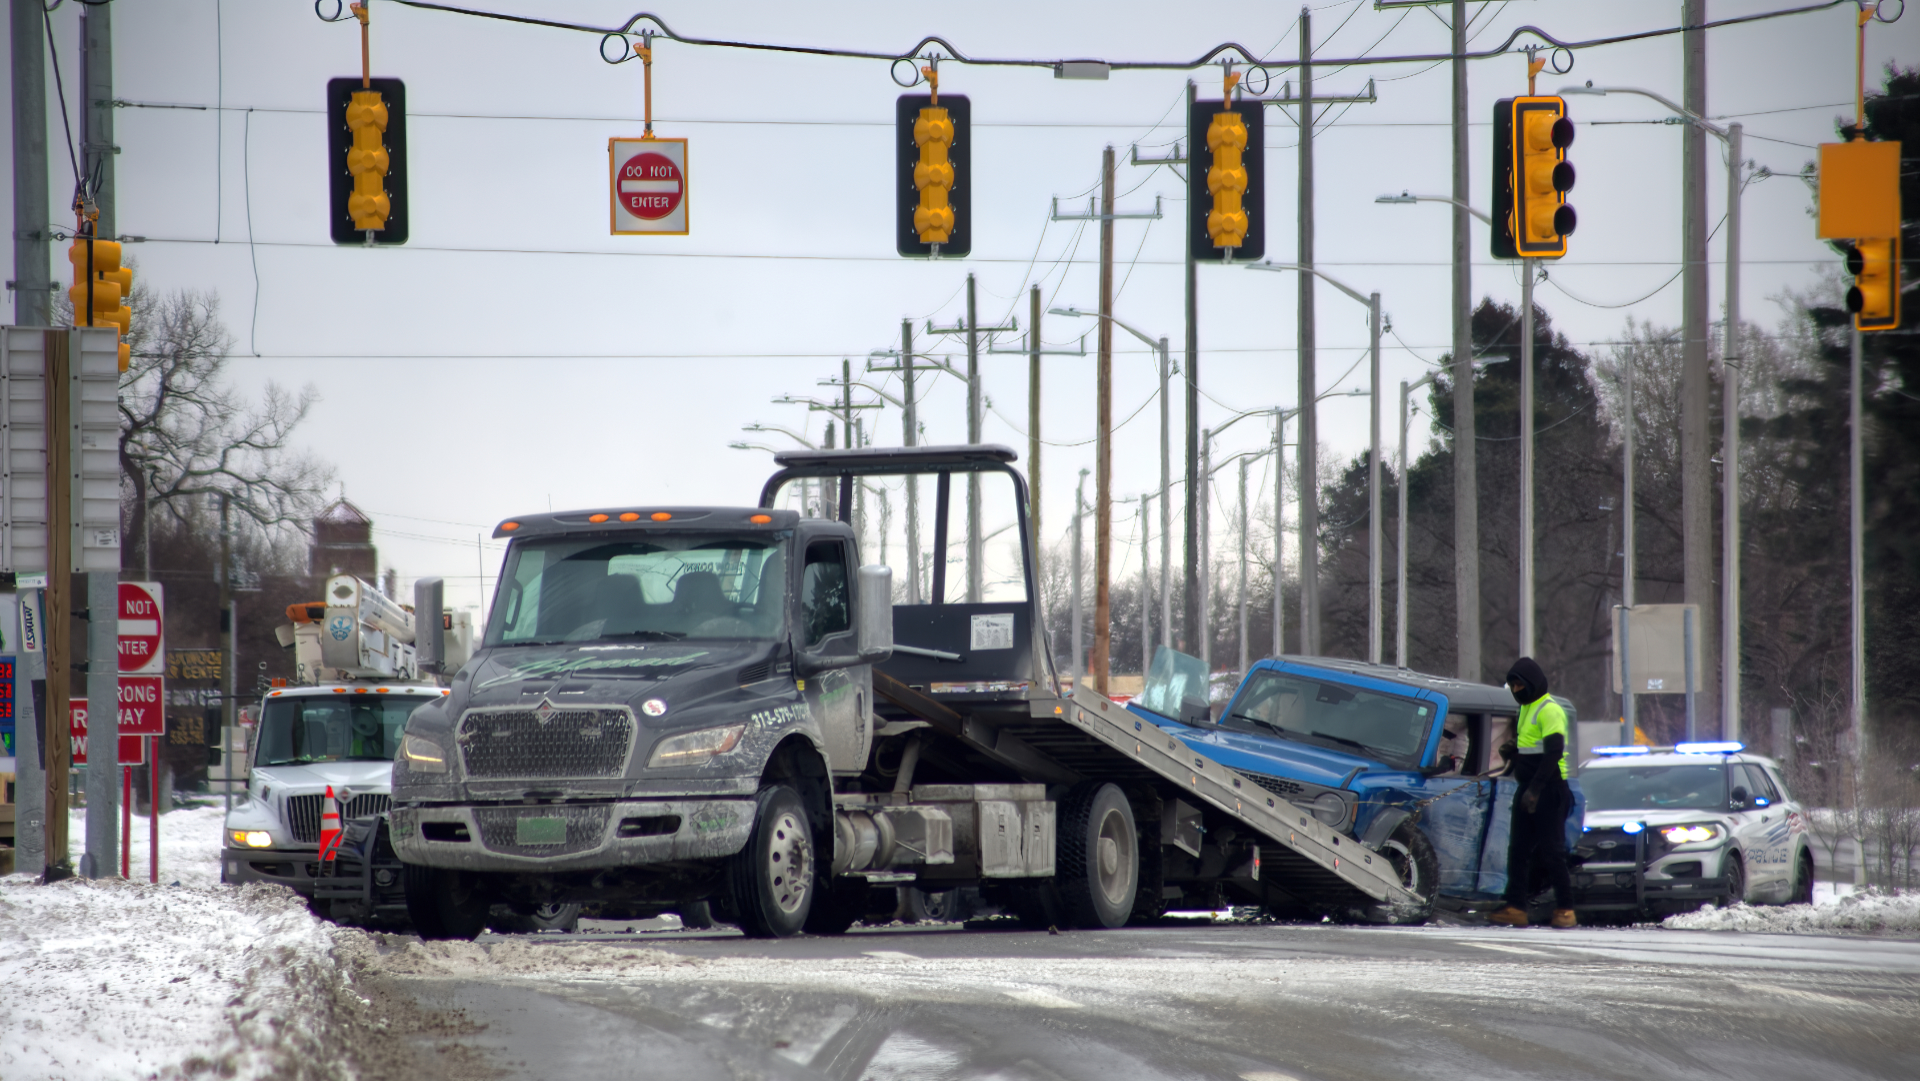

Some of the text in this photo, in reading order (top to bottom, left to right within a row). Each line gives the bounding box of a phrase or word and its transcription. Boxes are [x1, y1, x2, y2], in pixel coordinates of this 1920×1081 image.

[626, 165, 673, 177] DO NOT
[631, 196, 669, 208] ENTER
[126, 600, 153, 615] NOT
[117, 641, 149, 655] NTER
[117, 685, 156, 703] RONG
[1748, 848, 1788, 864] POLICE
